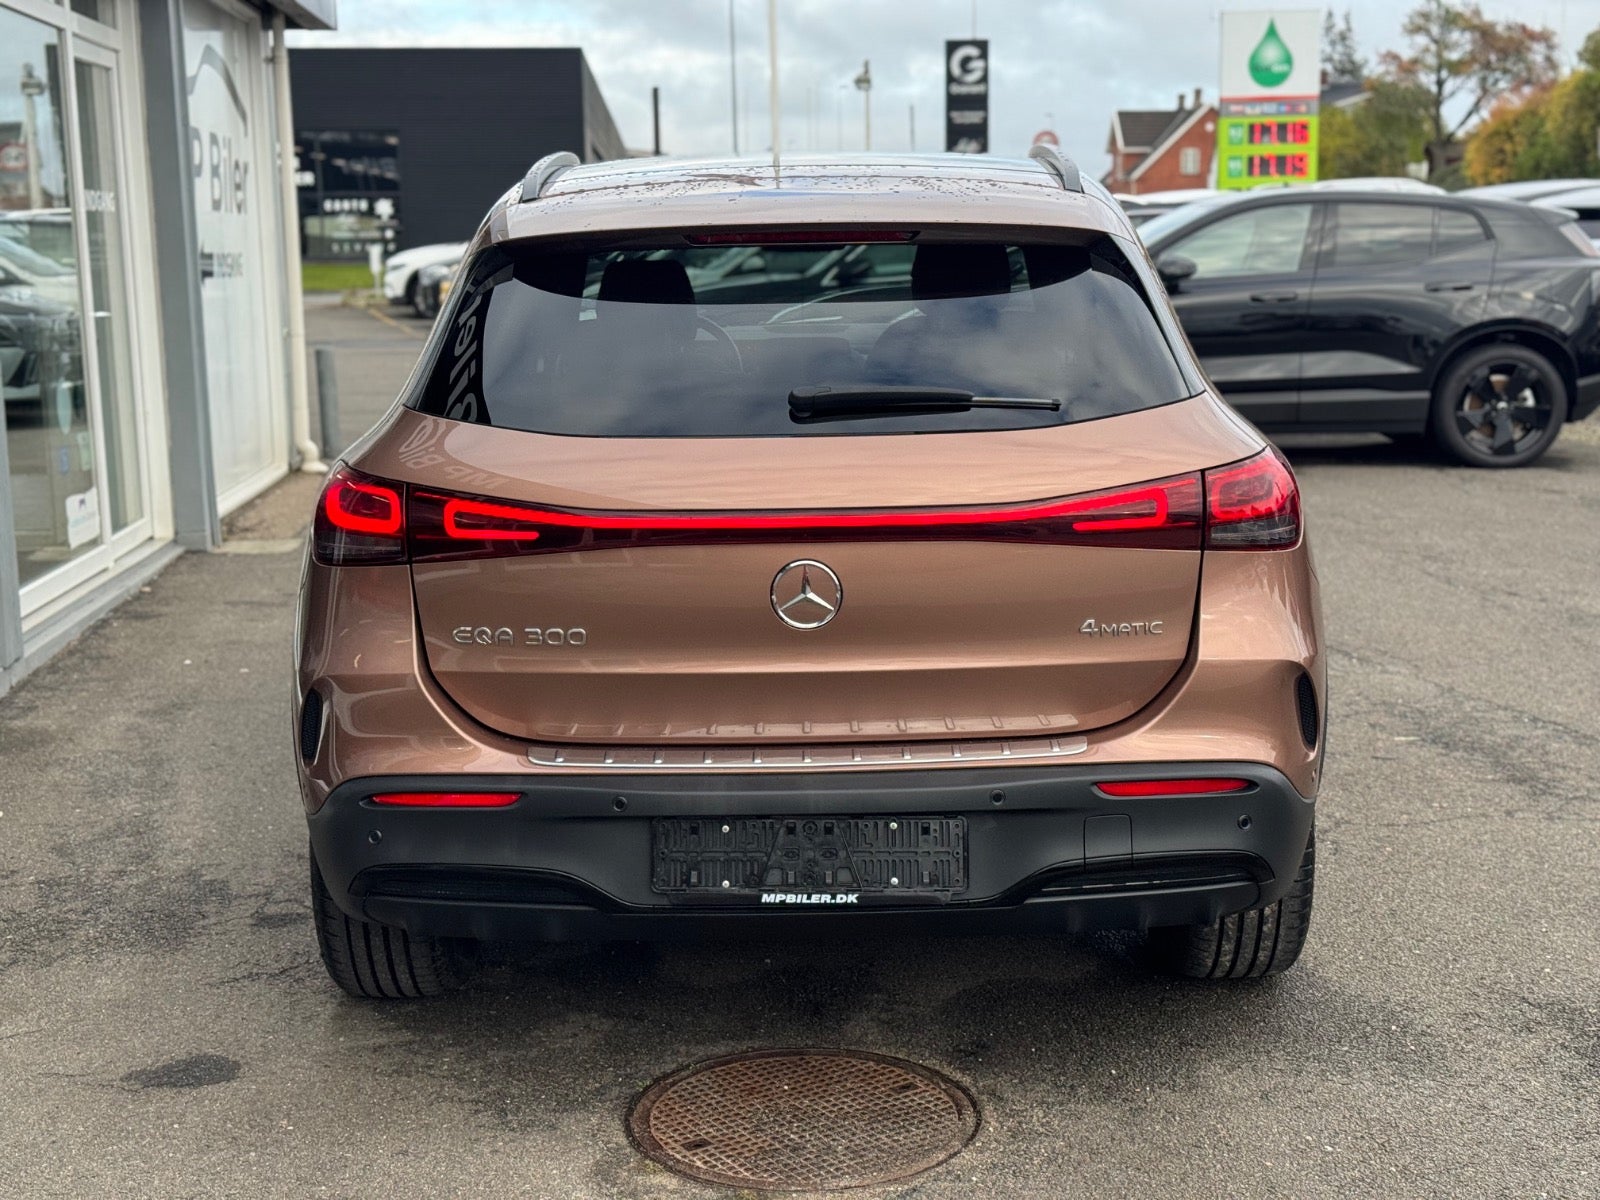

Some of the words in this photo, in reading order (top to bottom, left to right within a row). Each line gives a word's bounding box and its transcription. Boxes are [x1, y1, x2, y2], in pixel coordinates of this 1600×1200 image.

[209, 131, 248, 215] Biler
[452, 626, 514, 646] EQA
[523, 627, 587, 646] 300
[1079, 618, 1164, 637] 4MATIC
[761, 893, 860, 904] MPBILER.DK
